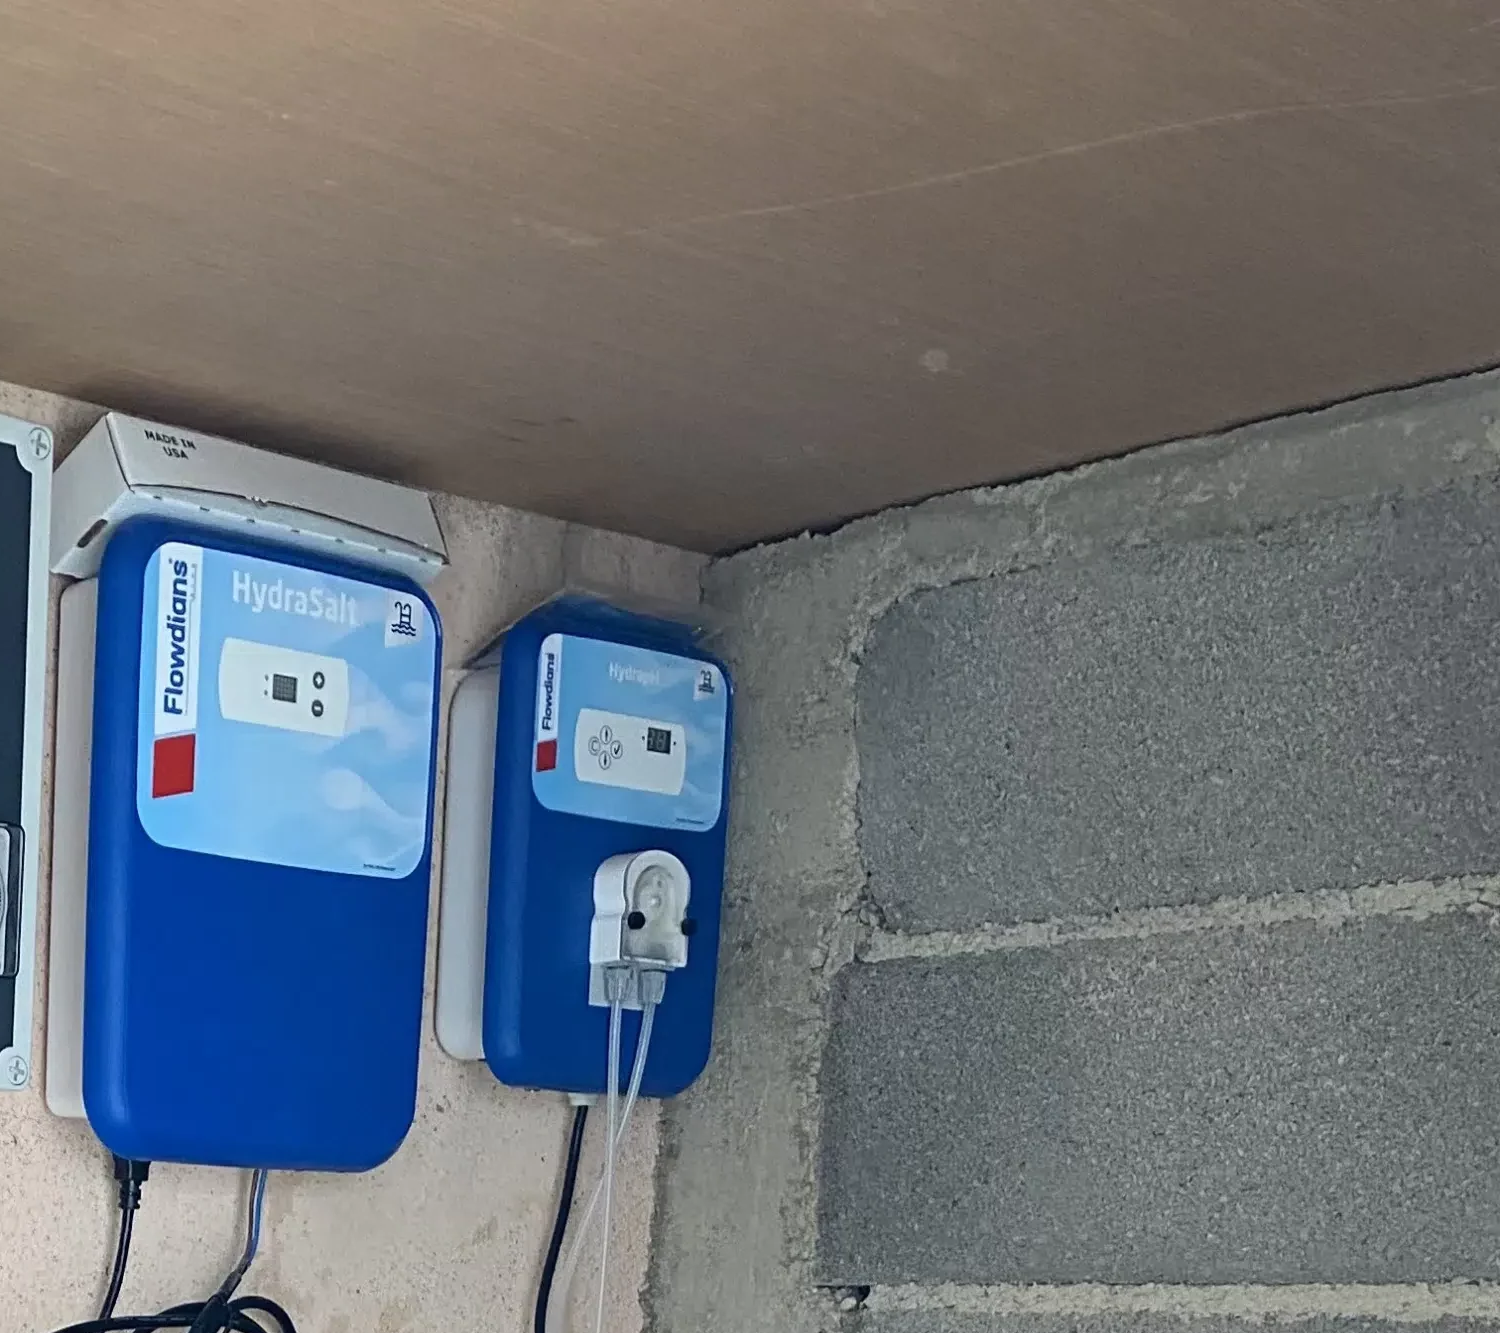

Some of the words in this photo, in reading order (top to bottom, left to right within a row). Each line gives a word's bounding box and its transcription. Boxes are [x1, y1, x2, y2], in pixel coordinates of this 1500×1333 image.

[144, 429, 179, 445] MADE
[180, 438, 196, 450] IN
[163, 446, 189, 460] USA
[232, 570, 361, 627] HydraSalt
[164, 559, 188, 715] Flowdians
[542, 653, 556, 731] Flowdians
